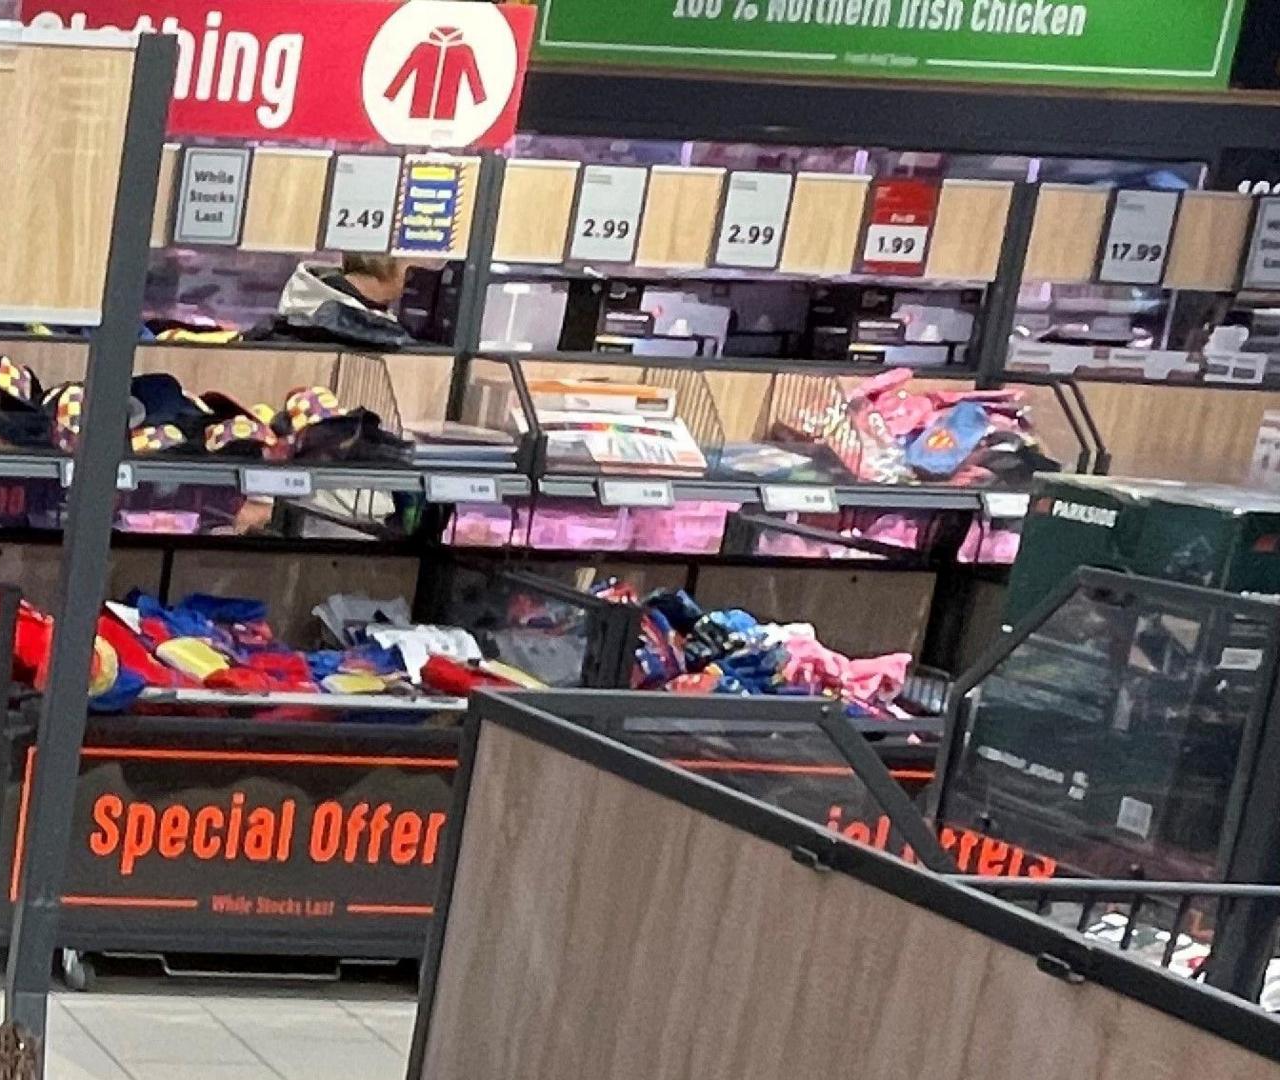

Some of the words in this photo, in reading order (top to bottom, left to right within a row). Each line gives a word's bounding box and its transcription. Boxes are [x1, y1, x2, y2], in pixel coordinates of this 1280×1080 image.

[897, 0, 963, 31] Irish
[970, 0, 1087, 36] Chicken
[30, 11, 304, 129] hing
[194, 169, 234, 184] While
[190, 189, 235, 203] Stocks
[194, 209, 223, 222] Last
[337, 208, 385, 230] 2.49
[582, 218, 630, 239] 2.99
[727, 224, 775, 245] 2.99
[878, 236, 915, 255] 1.99
[1111, 242, 1162, 263] 17.99
[90, 792, 295, 876] Special
[309, 800, 446, 866] Offer
[211, 894, 252, 913] While
